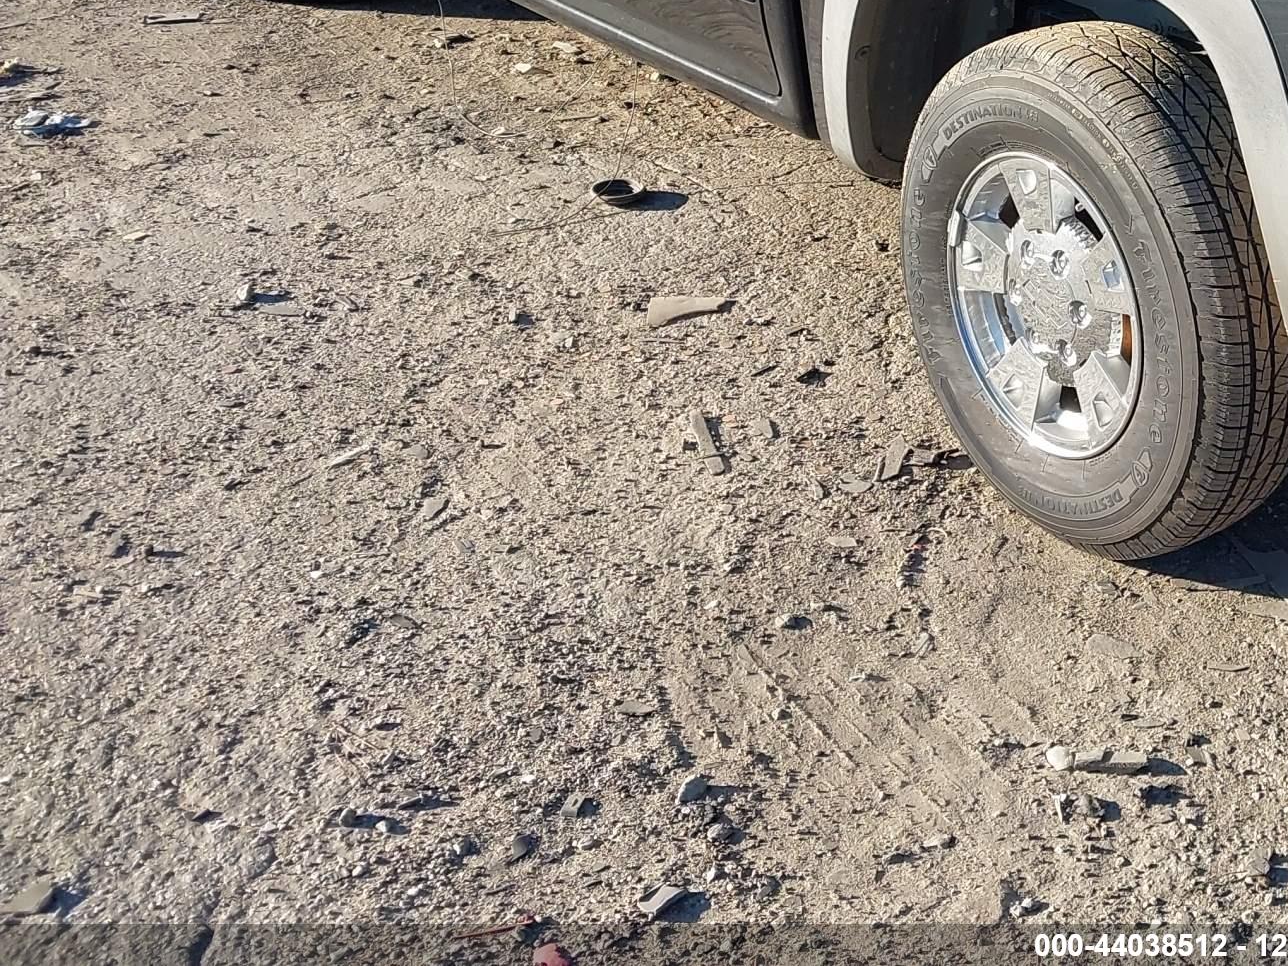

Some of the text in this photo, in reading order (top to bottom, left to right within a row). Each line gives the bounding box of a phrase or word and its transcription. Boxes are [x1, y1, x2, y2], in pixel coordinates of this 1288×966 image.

[943, 103, 1022, 140] DESTINATION
[908, 187, 942, 365] Firestone
[1132, 239, 1173, 445] Firestone
